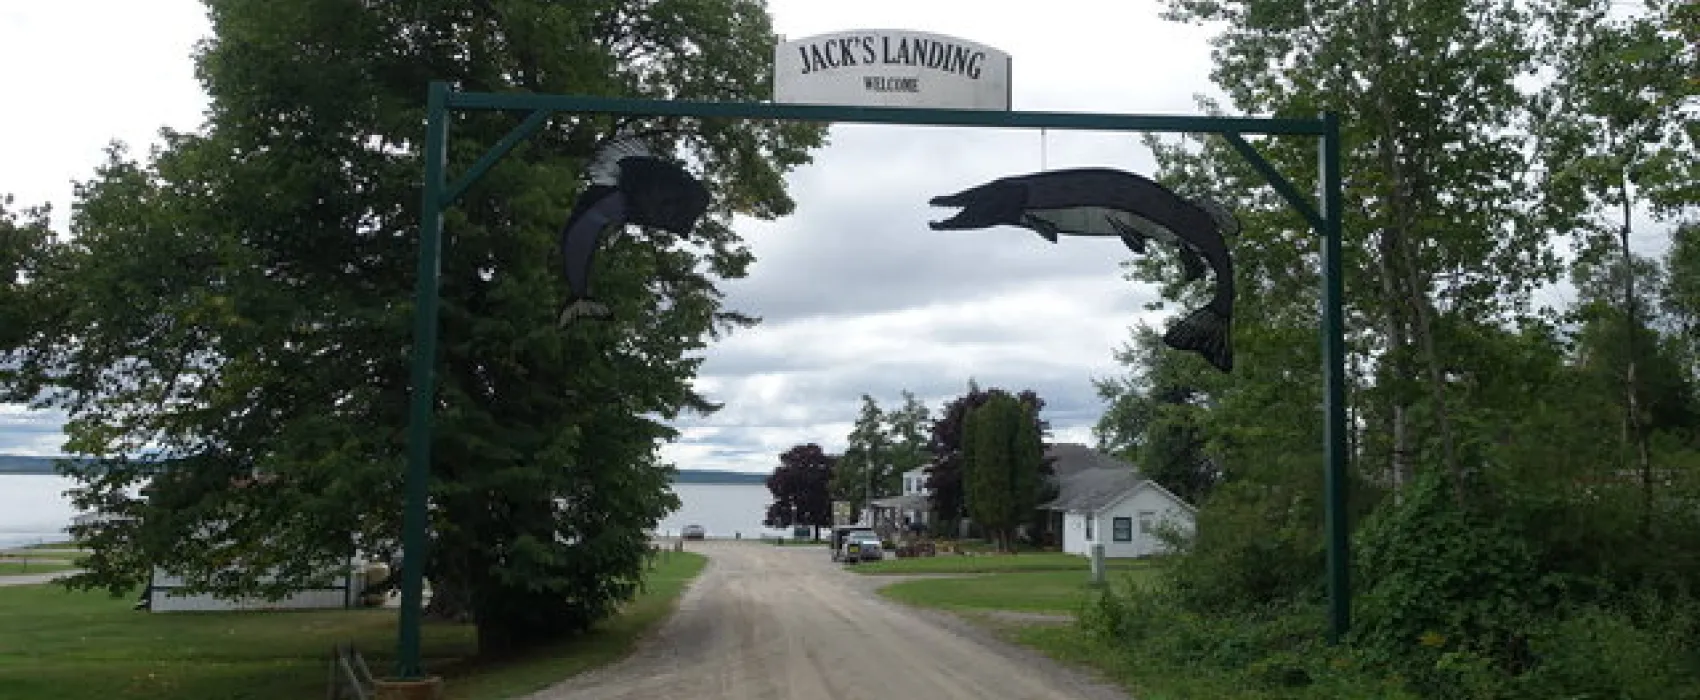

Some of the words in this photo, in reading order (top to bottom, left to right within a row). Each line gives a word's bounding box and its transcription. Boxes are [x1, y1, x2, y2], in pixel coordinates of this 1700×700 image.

[799, 36, 876, 74] JACK'S
[883, 36, 986, 79] LANDING
[863, 76, 919, 92] WELCOME
